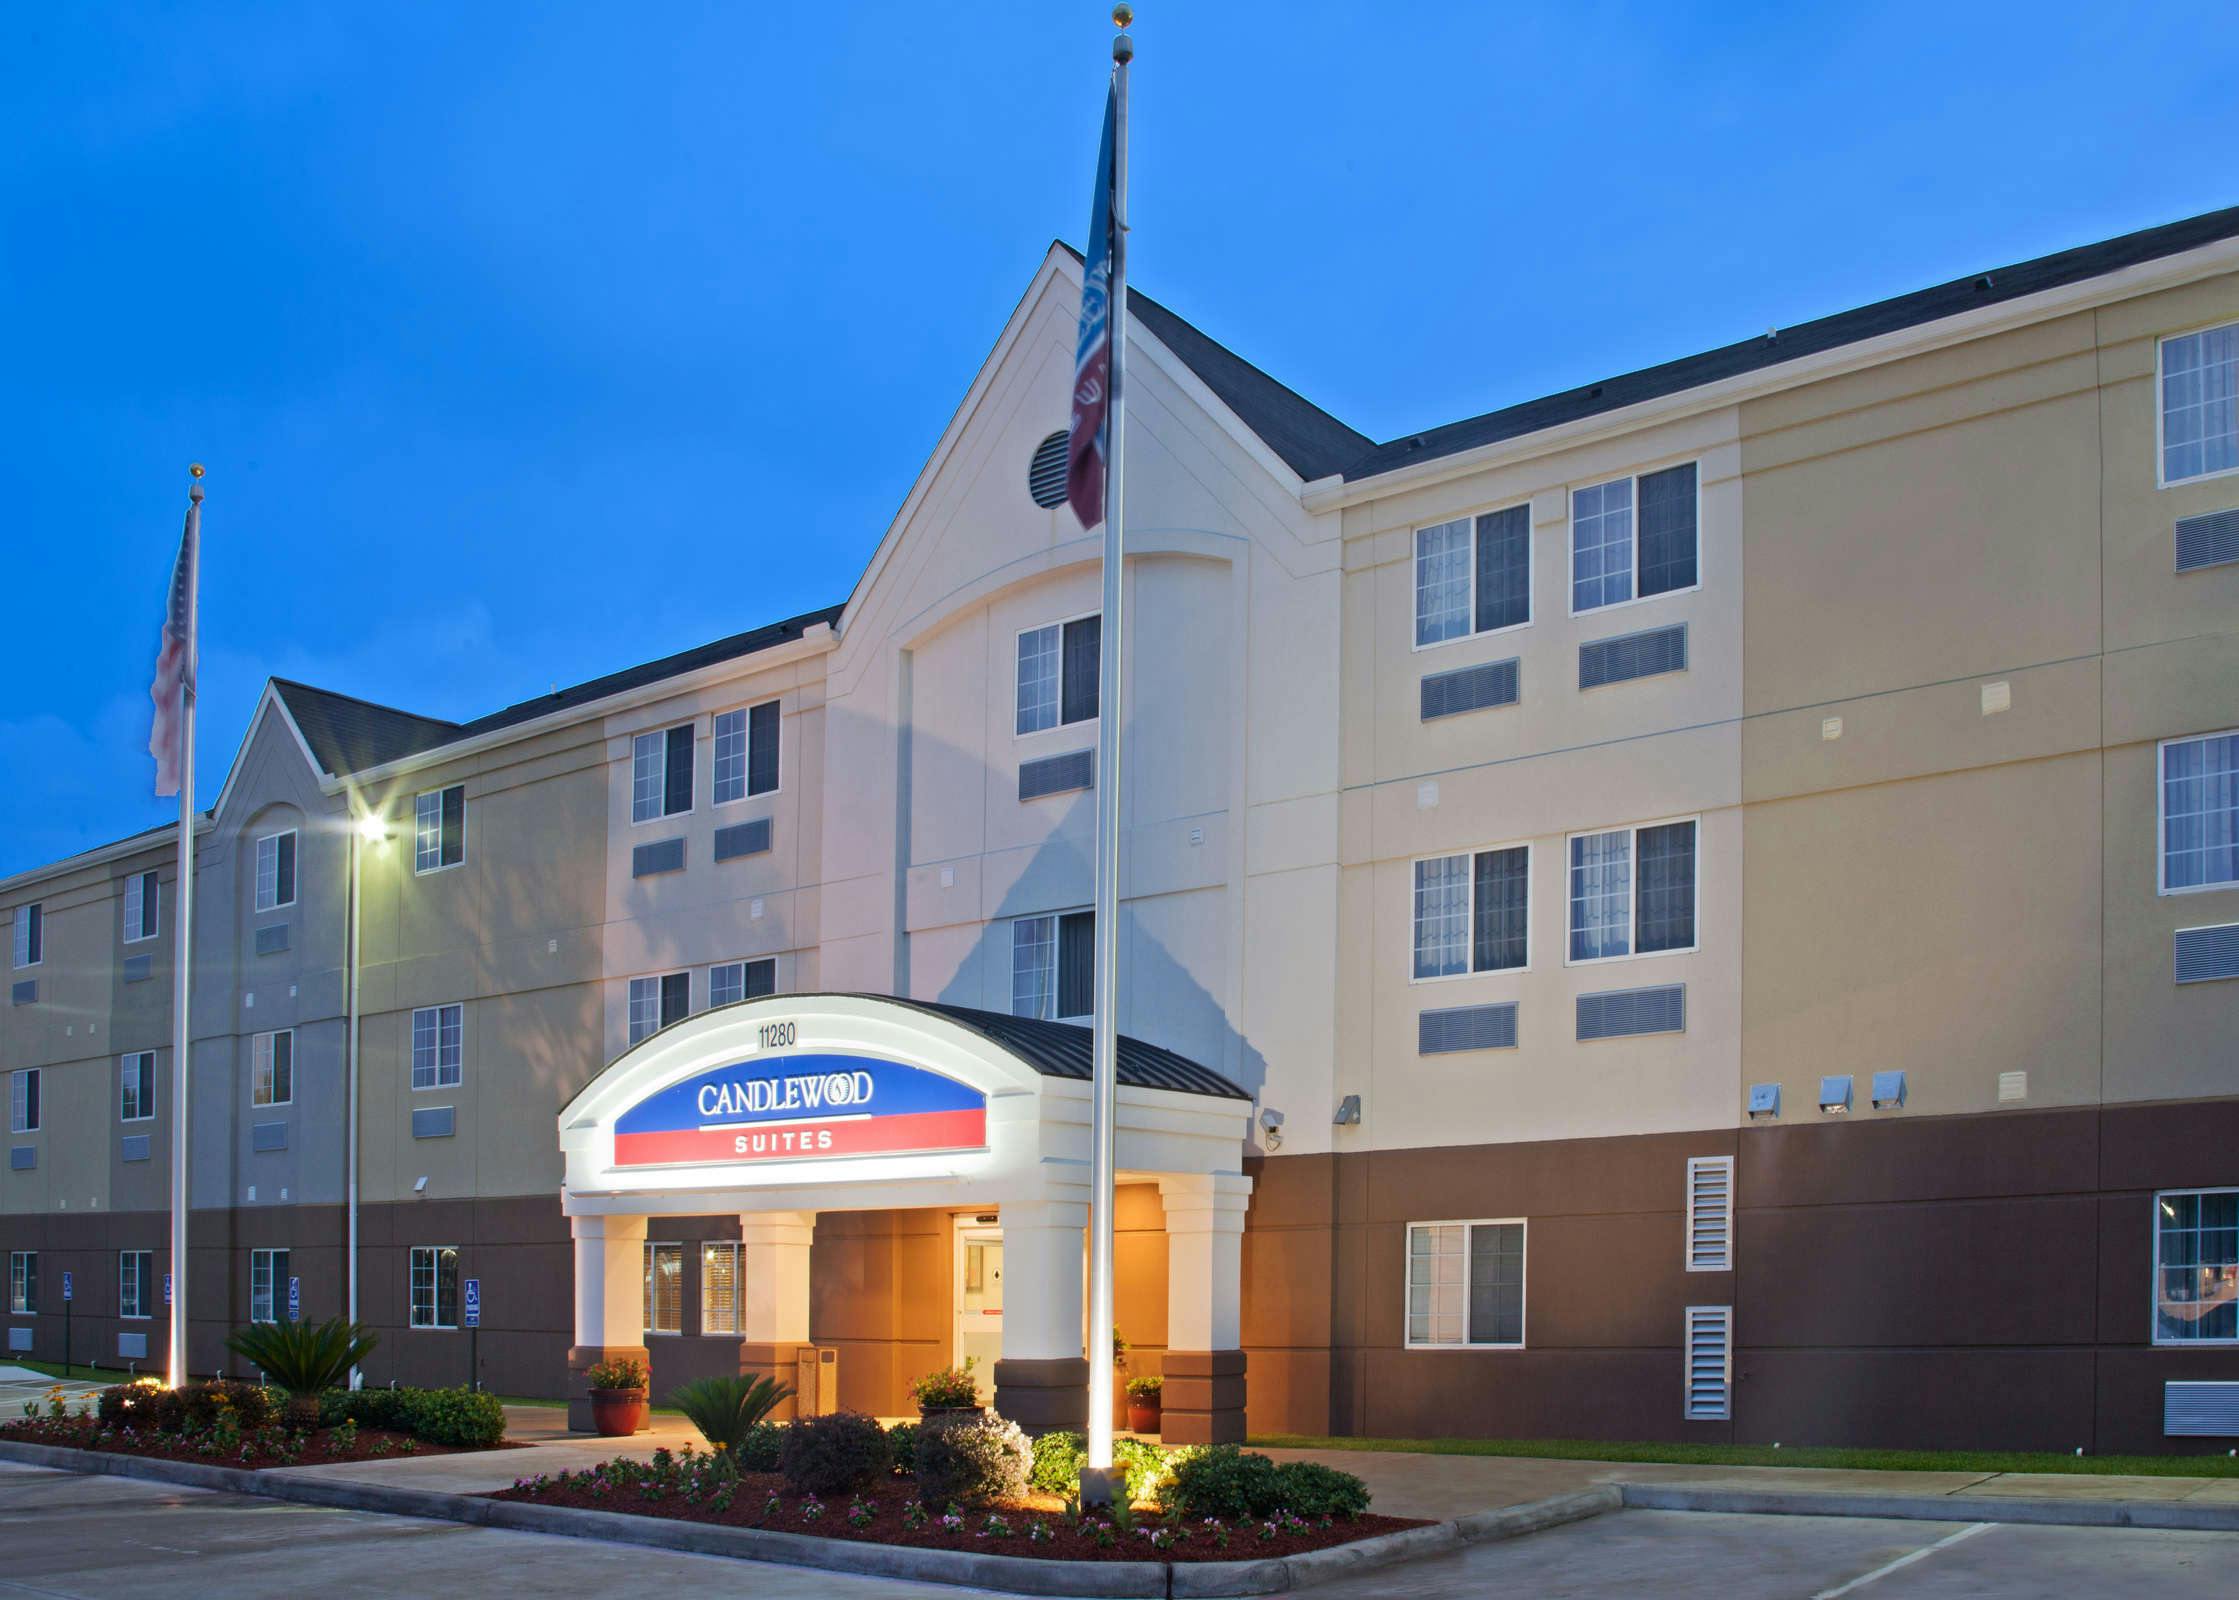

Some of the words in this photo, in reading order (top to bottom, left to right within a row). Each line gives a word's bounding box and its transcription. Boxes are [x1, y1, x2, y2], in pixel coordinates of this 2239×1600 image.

[759, 1022, 796, 1048] 11280
[698, 1071, 874, 1116] CANDLEWOOD
[735, 1130, 833, 1153] SUITES
